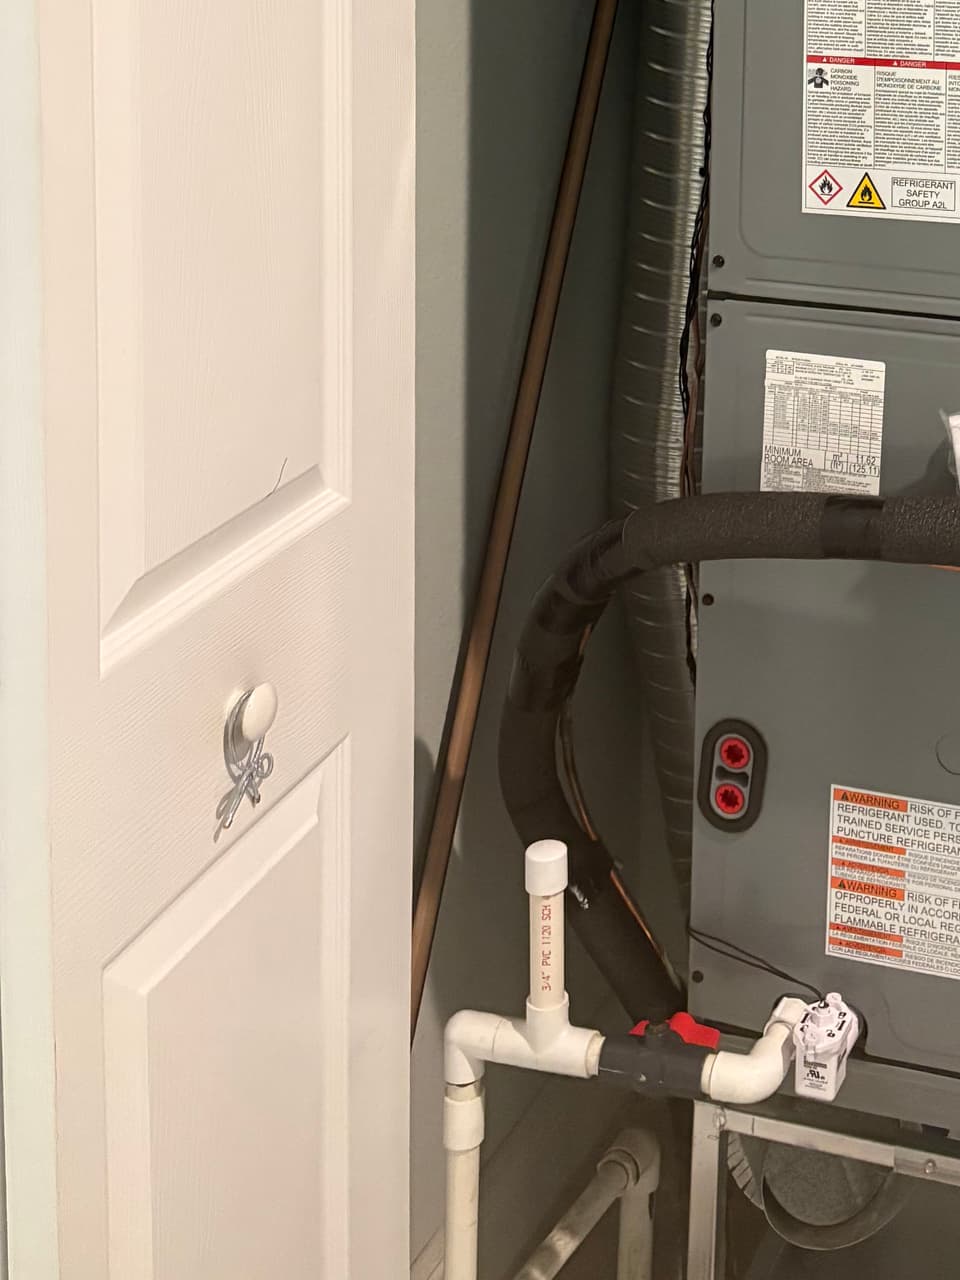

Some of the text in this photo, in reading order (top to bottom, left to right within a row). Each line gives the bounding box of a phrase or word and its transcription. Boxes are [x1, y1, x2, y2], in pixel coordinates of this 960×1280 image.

[893, 179, 953, 190] REFRIGERANT
[907, 190, 940, 199] SAFETY
[899, 199, 946, 209] GROUP A2L
[765, 446, 801, 456] MINIMUM
[765, 454, 813, 467] ROOM AREA
[838, 803, 911, 824] REFRIGERANT
[849, 794, 899, 809] WARNING
[910, 804, 934, 816] RISK
[937, 809, 951, 818] OF
[837, 826, 893, 844] PUNCTURE
[838, 814, 882, 830] TRAINED
[885, 823, 930, 839] SERVICE
[835, 891, 904, 911] OFPROPERLY
[908, 904, 918, 914] IN
[848, 881, 897, 898] WARNING
[908, 892, 931, 904] RISK
[935, 898, 949, 906] OF
[542, 905, 551, 920] SCH
[835, 902, 881, 919] FEDERAL
[885, 911, 900, 922] OR
[903, 915, 936, 929] LOCAL
[835, 914, 896, 933] FLAMMABLE
[542, 926, 551, 944] 1120
[542, 950, 551, 966] PVC
